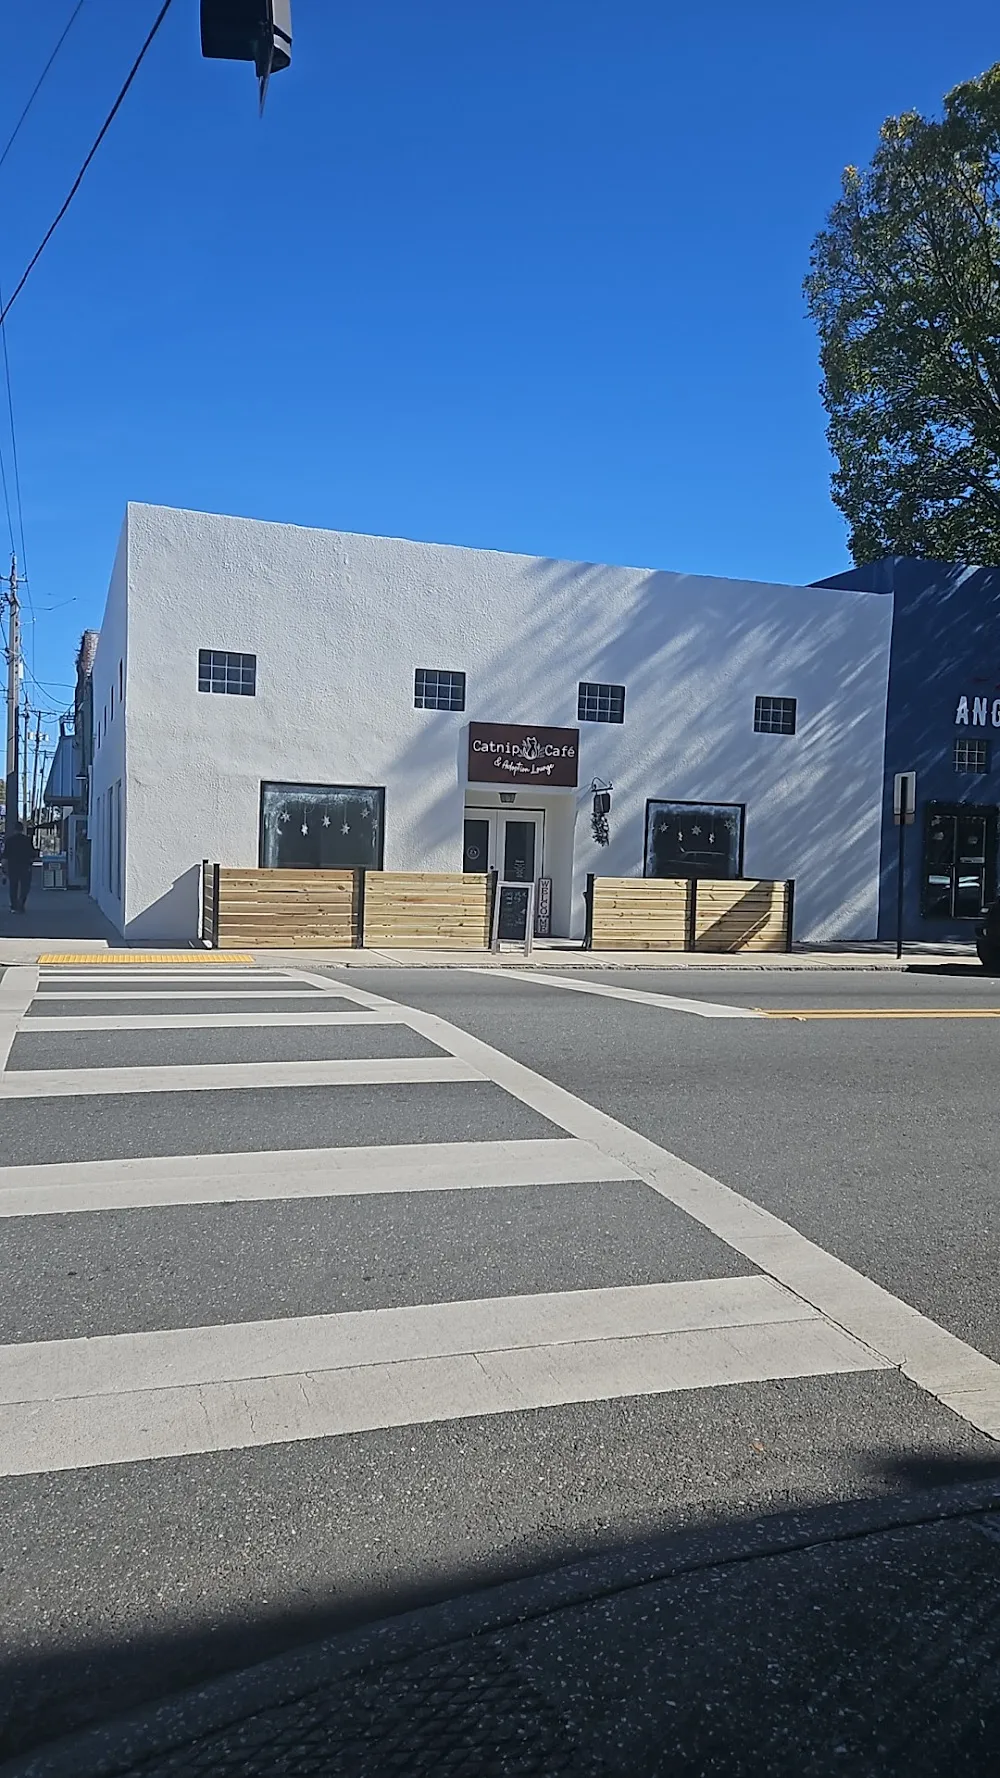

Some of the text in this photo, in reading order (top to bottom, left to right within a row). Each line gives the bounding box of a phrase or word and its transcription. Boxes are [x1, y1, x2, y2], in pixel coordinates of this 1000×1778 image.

[472, 739, 576, 758] Catnip Café
[493, 757, 555, 777] & Adoption Lounge
[539, 880, 550, 933] WELCOME
